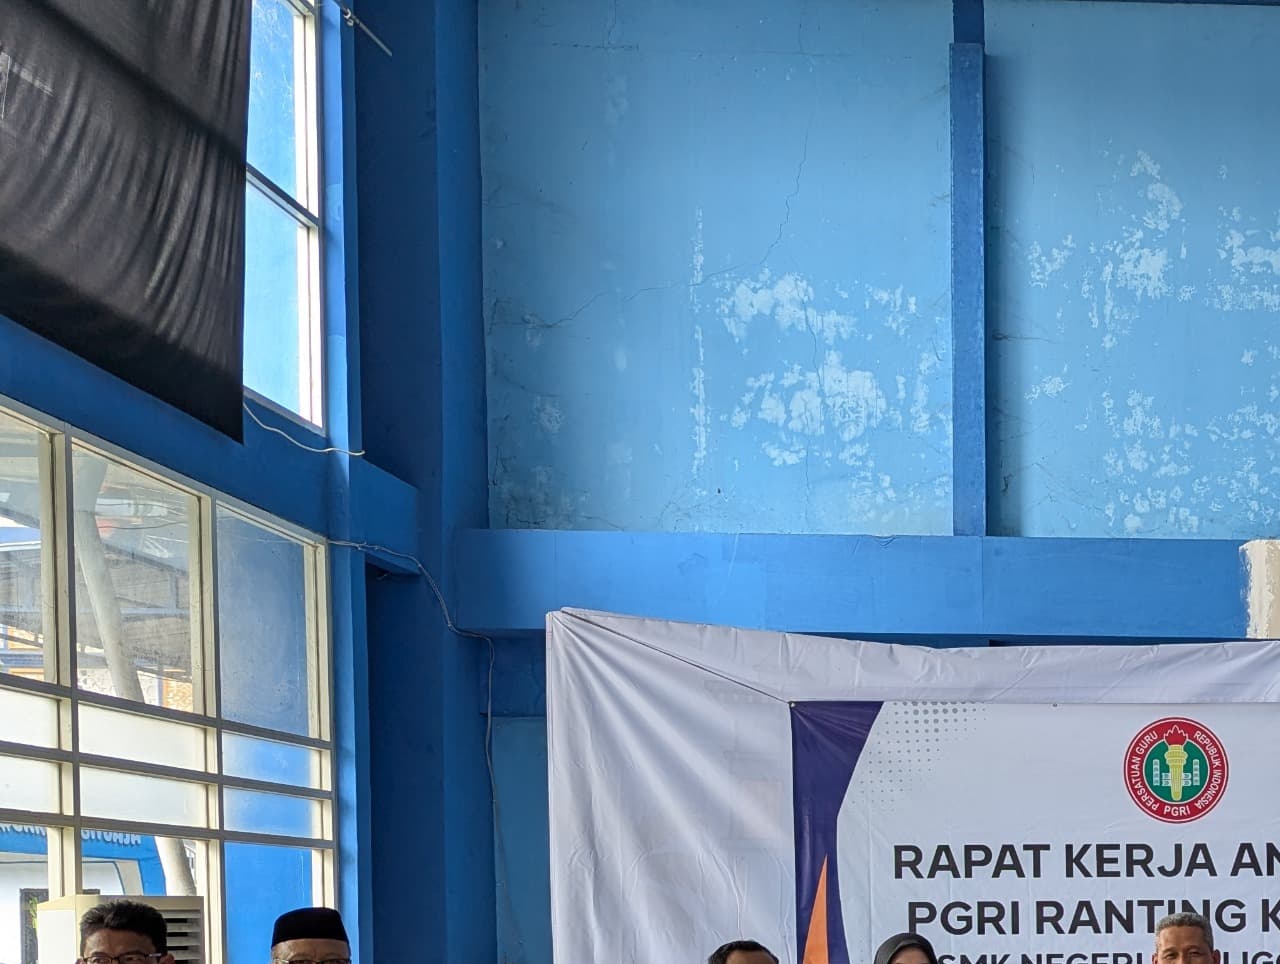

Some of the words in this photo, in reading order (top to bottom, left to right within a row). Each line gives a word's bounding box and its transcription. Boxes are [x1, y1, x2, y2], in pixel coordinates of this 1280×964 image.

[1135, 731, 1158, 755] GURU
[1193, 730, 1222, 768] REPUBLIK
[1131, 756, 1160, 811] PERSATUAN
[1194, 769, 1223, 810] INDONESIA
[1163, 805, 1191, 817] PGRI
[893, 843, 1051, 880] RAPAT
[1065, 842, 1218, 879] KERJA
[908, 900, 1020, 936] PGRI
